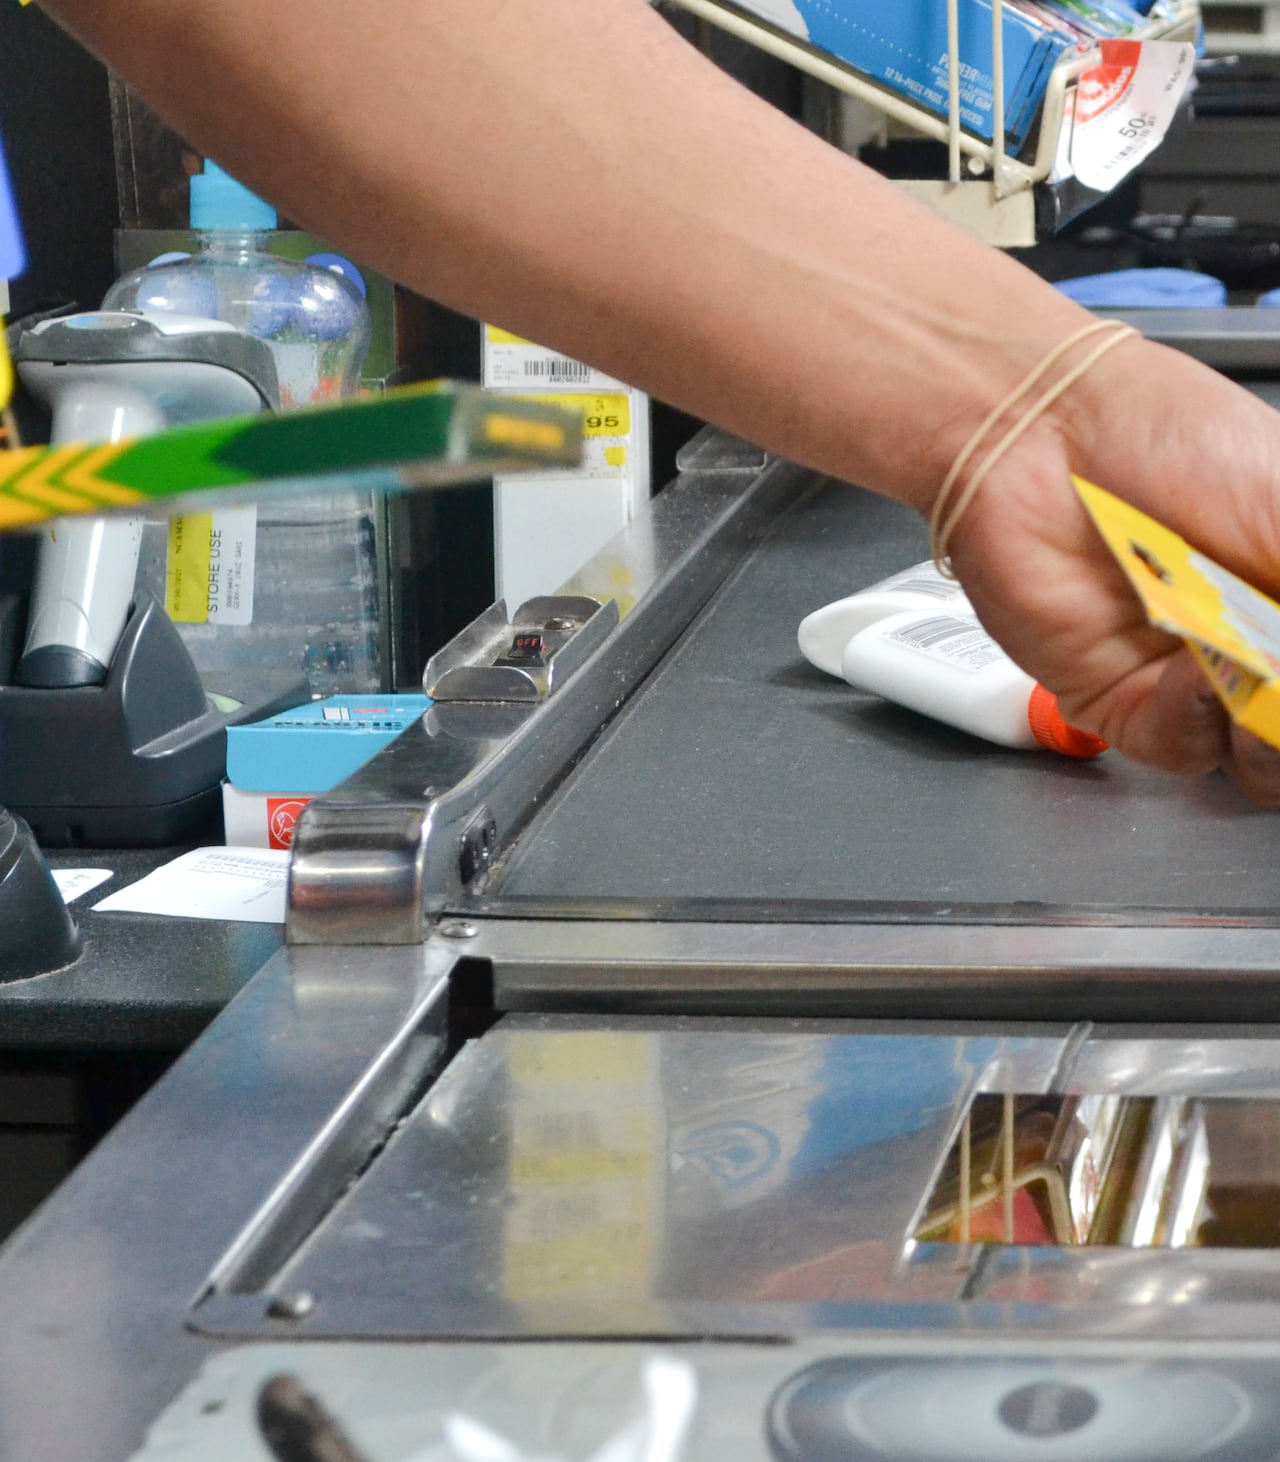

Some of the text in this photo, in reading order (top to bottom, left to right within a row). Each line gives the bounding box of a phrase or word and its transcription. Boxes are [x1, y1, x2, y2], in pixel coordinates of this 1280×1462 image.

[586, 415, 620, 429] 95
[207, 529, 222, 613] STORE USE
[516, 637, 538, 647] OFF
